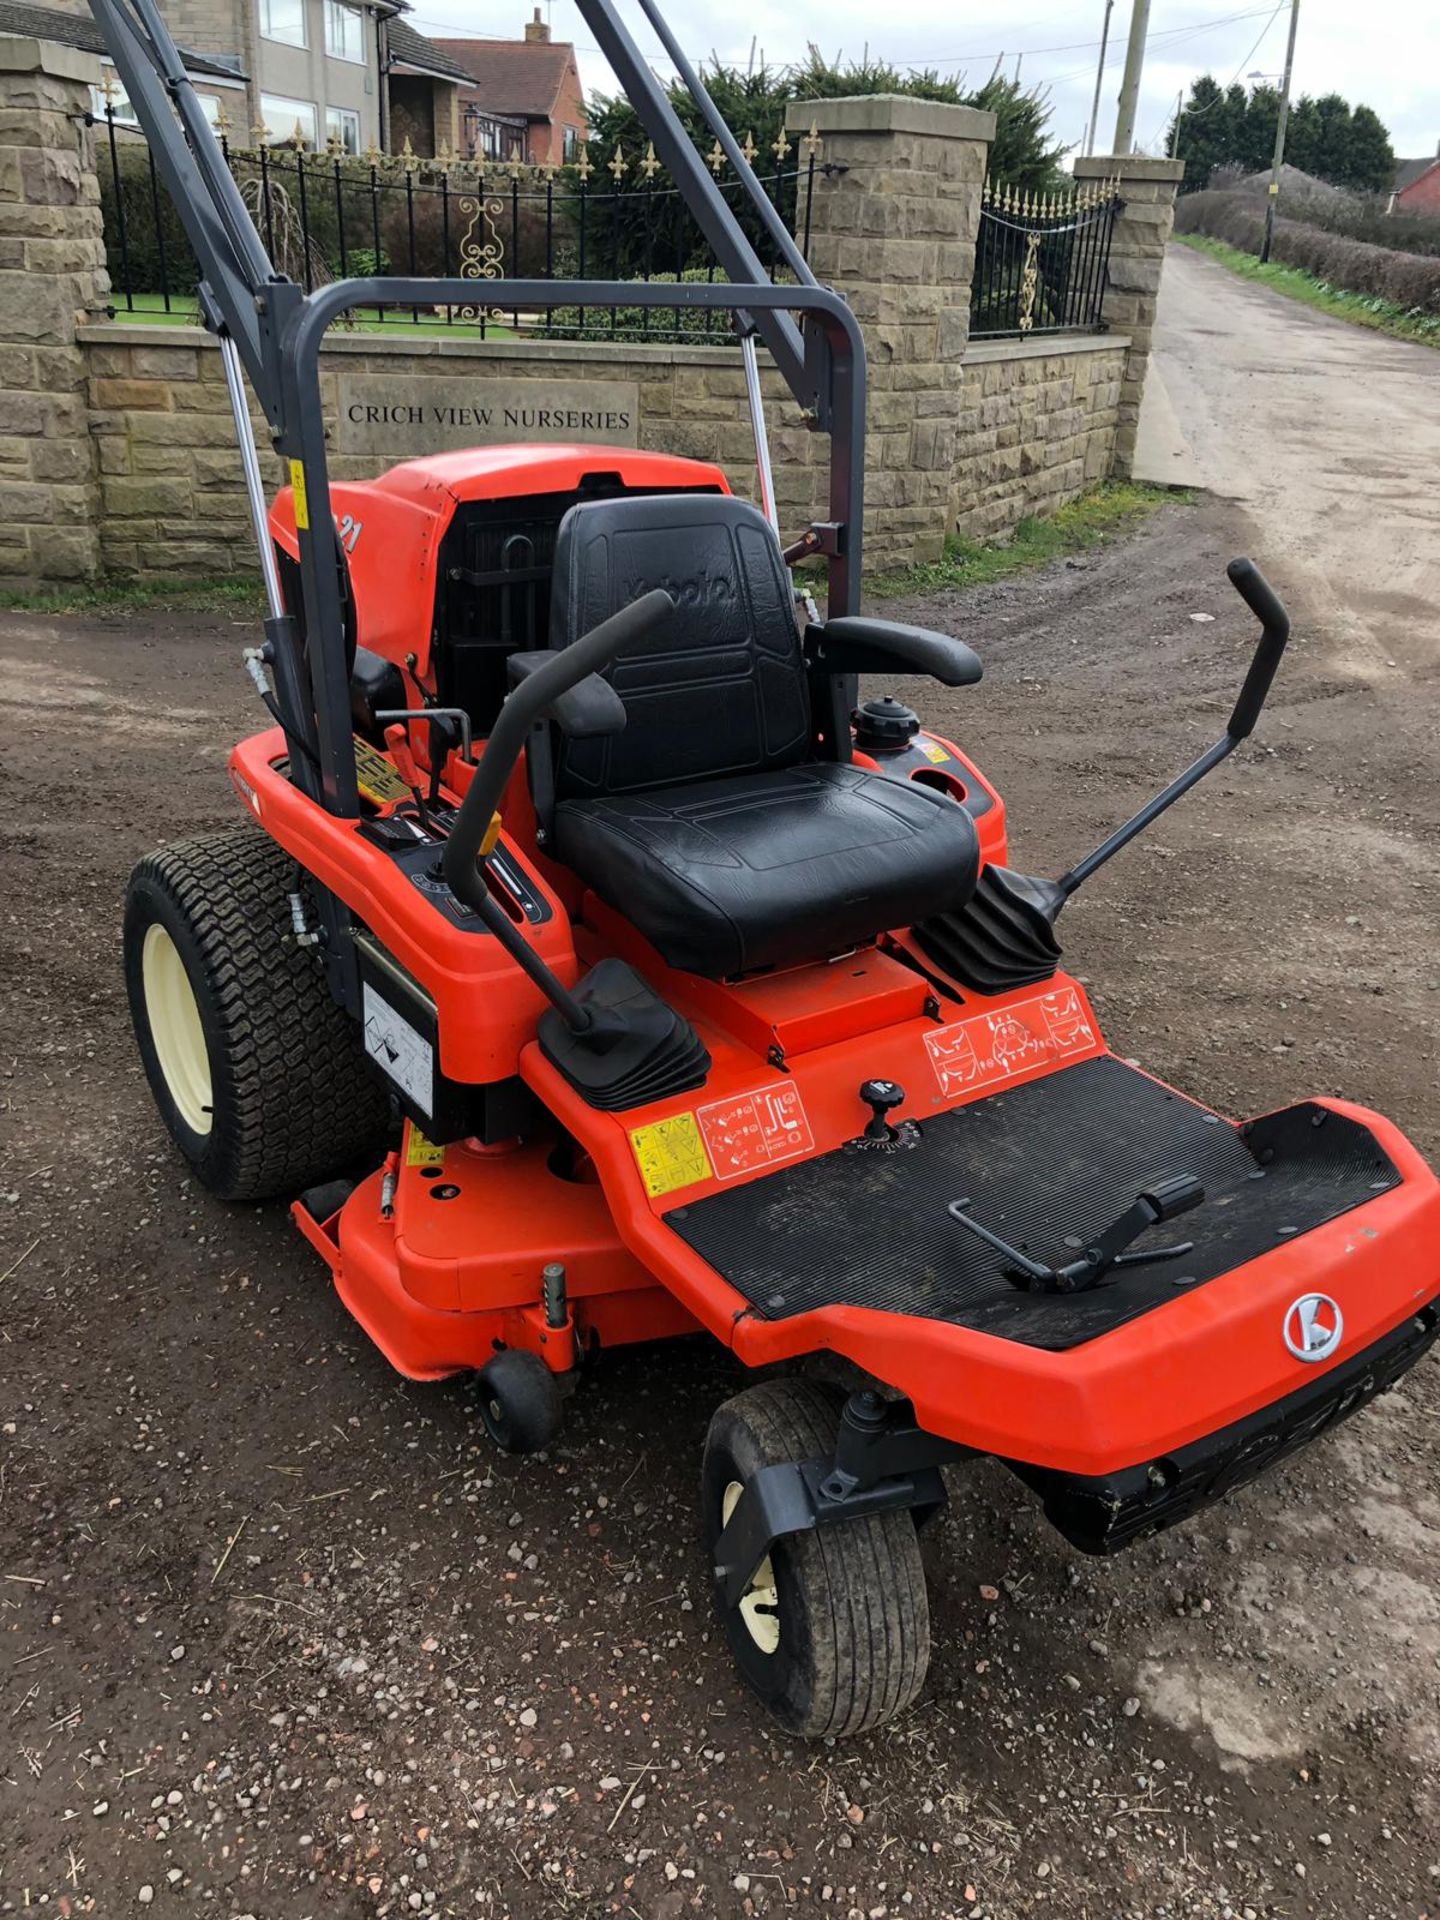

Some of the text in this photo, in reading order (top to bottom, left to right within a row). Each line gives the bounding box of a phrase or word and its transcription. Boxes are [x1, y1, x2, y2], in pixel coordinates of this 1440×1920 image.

[348, 404, 630, 431] CRICH VIEW NURSERIES
[622, 570, 737, 607] Kbota
